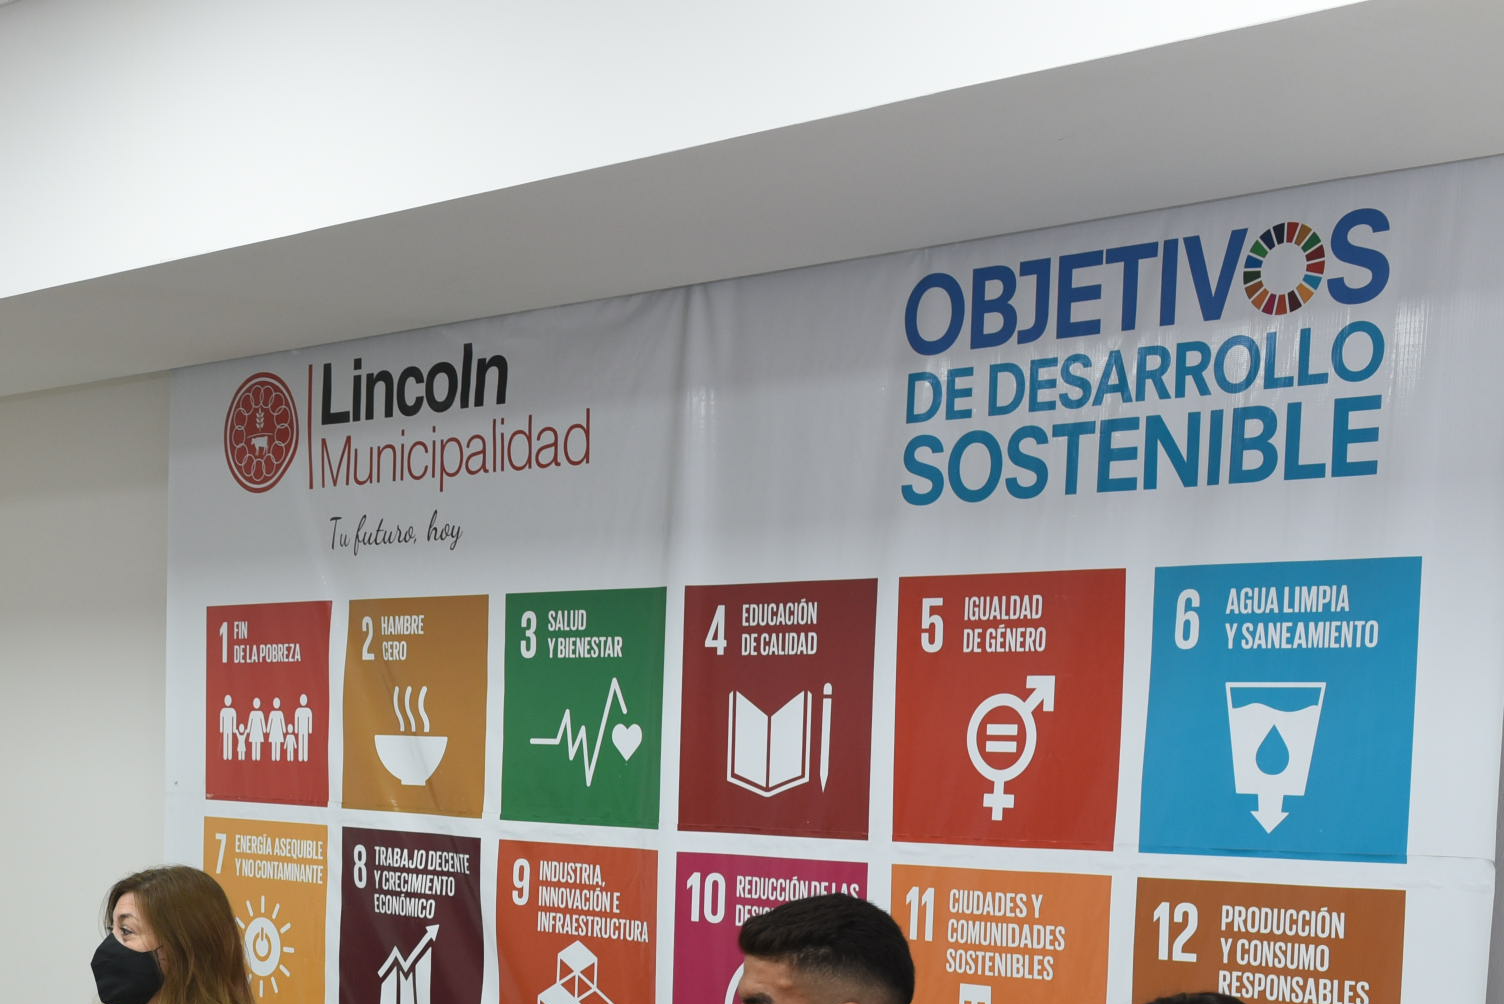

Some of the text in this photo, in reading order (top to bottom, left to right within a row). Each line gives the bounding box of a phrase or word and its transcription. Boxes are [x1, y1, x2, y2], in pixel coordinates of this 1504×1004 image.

[905, 208, 1390, 356] OBJETIVOS
[321, 343, 508, 425] Lincoln
[906, 320, 1386, 424] DE DESARROLLO
[321, 408, 591, 492] Municipalidad
[901, 395, 1383, 506] SOSTENIBLE
[330, 509, 462, 556] Tu futuro, hoy
[742, 598, 817, 627] EDUCACIÓN
[964, 594, 1043, 621] IGUALDAD
[1225, 585, 1350, 615] AGUA LIMPIA
[234, 620, 248, 640] FIN
[381, 615, 424, 635] HAMBRE
[520, 610, 537, 659] 3
[548, 609, 587, 631] SALUD
[704, 604, 727, 655] 4
[921, 597, 944, 653] 5
[1174, 588, 1200, 650] 6
[1225, 620, 1379, 650] Y SANEAMIENTO
[219, 621, 228, 663] 1
[234, 643, 301, 663] DE LA POBREZA
[362, 616, 375, 661] 2
[382, 641, 407, 661] CERO
[548, 636, 623, 659] Y BIENESTAR
[741, 632, 817, 656] DE CALIDAD
[963, 624, 1047, 653] DE GÉNERO
[215, 833, 227, 874] 7
[235, 833, 323, 860] ENERGÍA ASEQUIBLE
[374, 845, 470, 875] TRABAJO DECENTE
[235, 857, 323, 884] Y NO CONTAMINANTE
[353, 844, 367, 889] 8
[374, 869, 455, 897] Y CRECIMIENTO
[512, 858, 531, 906] 9
[539, 860, 606, 888] INDUSTRIA,
[538, 885, 621, 914] INNOVACIÓN E
[686, 871, 726, 924] 10
[736, 875, 809, 902] REDUCCIÓN
[810, 880, 829, 897] DE
[949, 888, 1043, 919] CIUDADES Y
[374, 893, 436, 920] ECONÓMICO
[906, 886, 934, 942] 11
[1221, 905, 1345, 939] PRODUCCIÓN
[537, 911, 649, 944] INFRAESTRUCTURA
[947, 918, 1066, 951] COMUNIDADES
[1153, 901, 1199, 962] 12
[946, 948, 1054, 981] SOSTENIBLES
[1220, 937, 1330, 972] Y CONSUMO
